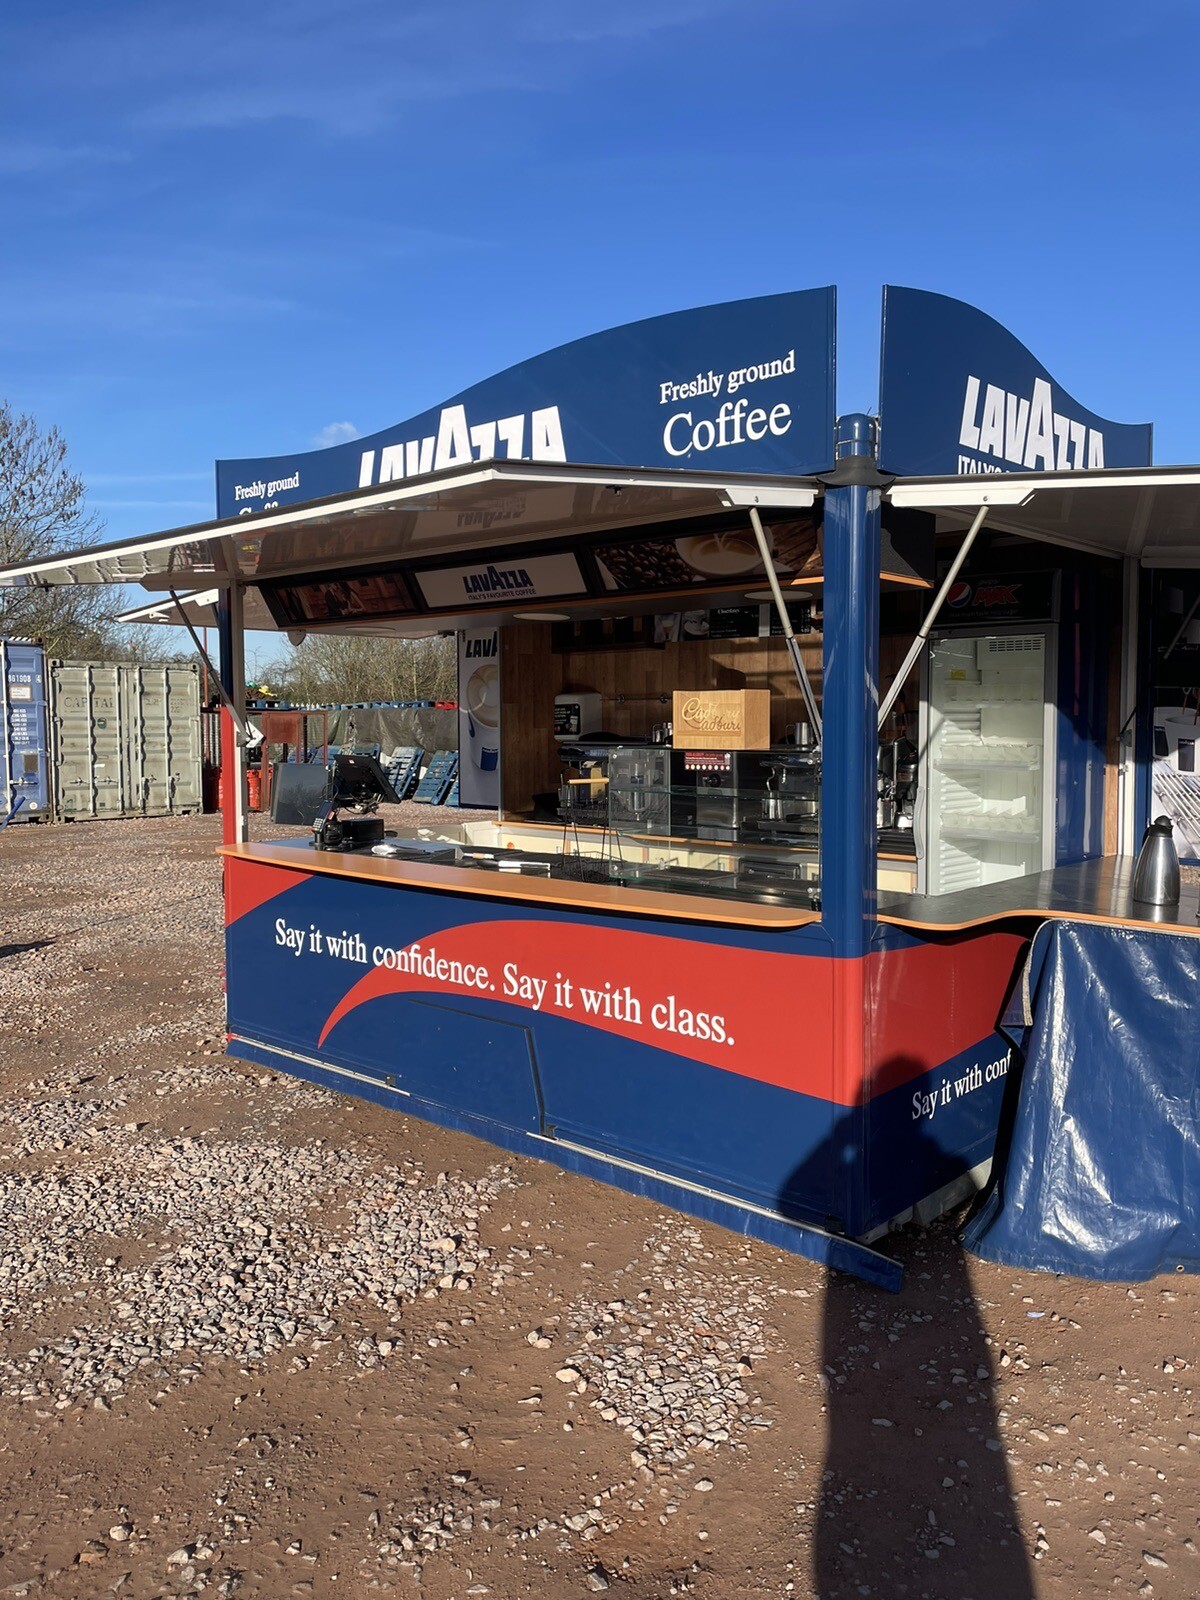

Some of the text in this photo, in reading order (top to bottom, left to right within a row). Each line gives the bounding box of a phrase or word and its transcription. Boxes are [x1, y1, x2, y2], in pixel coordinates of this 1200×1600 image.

[659, 349, 796, 404] Freshly ground
[358, 404, 567, 489] LAVAZZA
[663, 398, 792, 456] Coffee
[957, 375, 1106, 473] LAVAZZA
[234, 471, 300, 501] Freshly ground
[462, 565, 534, 594] LAVAZZA
[514, 588, 537, 597] COFFEE
[64, 696, 114, 708] CAPTAL
[275, 918, 735, 1046] Say it with confidence. Say it with class.
[911, 1090, 939, 1120] Say
[940, 1078, 952, 1106] it
[953, 1062, 983, 1098] with
